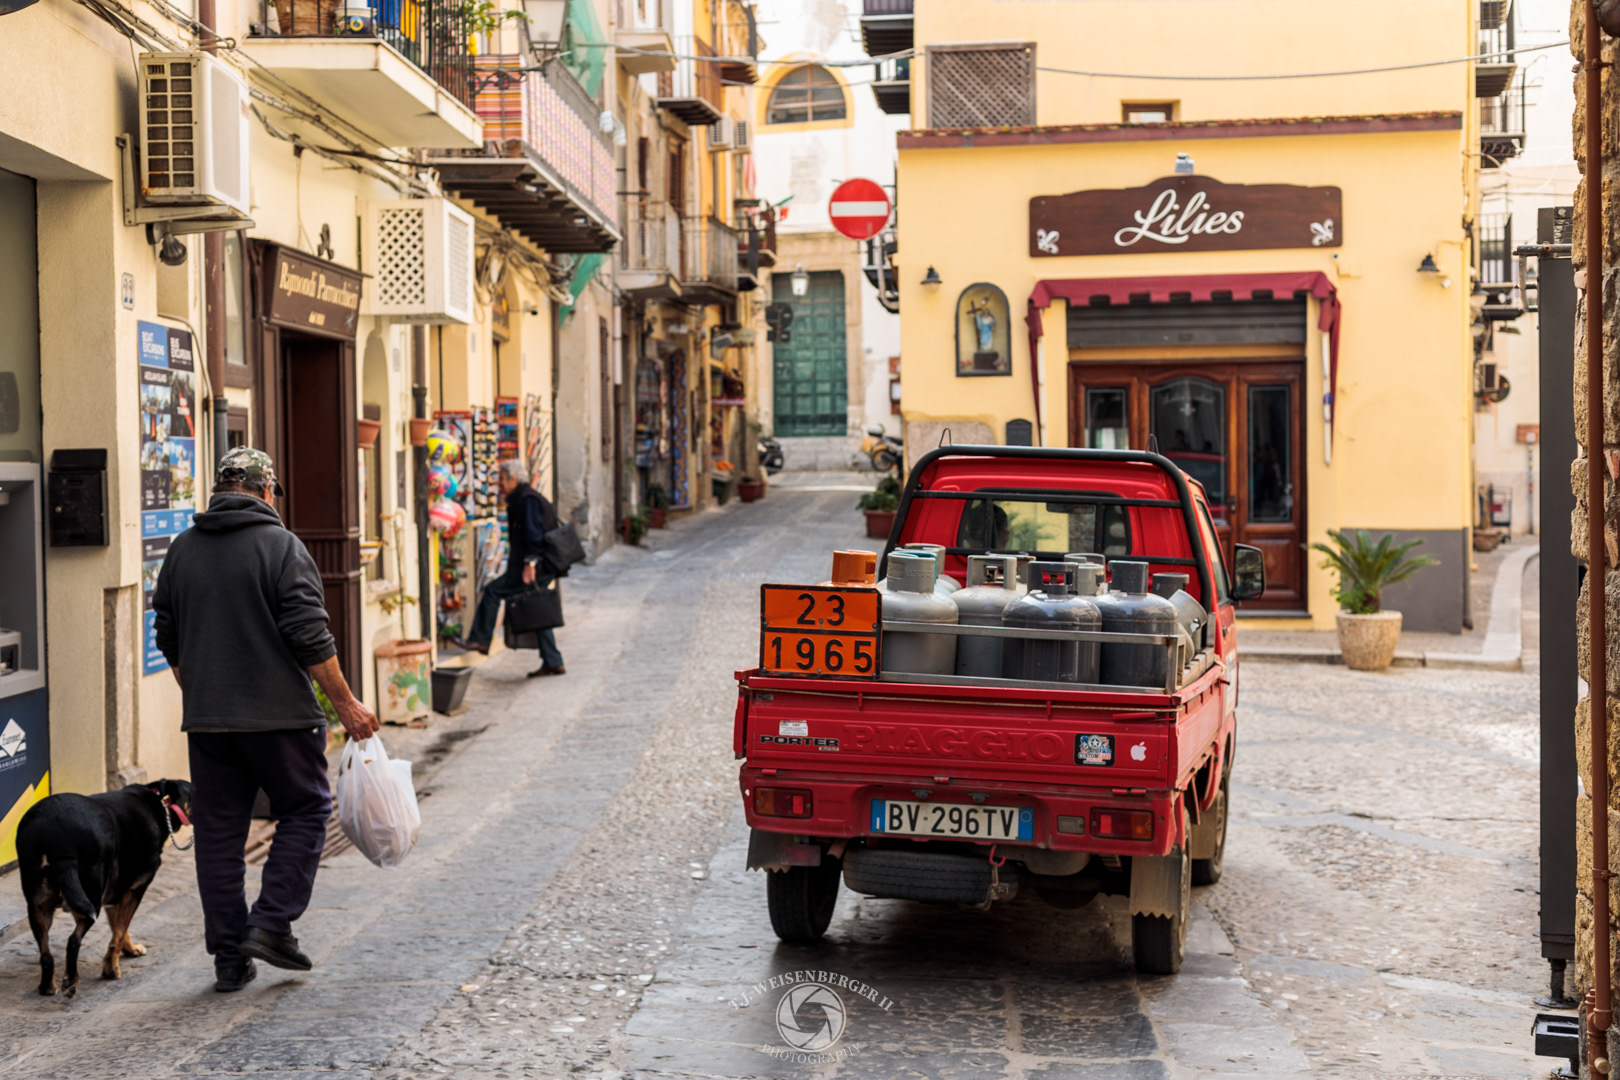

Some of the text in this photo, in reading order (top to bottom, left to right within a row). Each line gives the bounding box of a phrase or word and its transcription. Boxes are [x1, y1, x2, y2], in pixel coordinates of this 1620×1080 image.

[1114, 188, 1245, 247] Lilies
[797, 593, 845, 626] 23
[771, 636, 873, 673] 1965
[760, 735, 840, 748] PORTER
[842, 724, 1066, 763] PIAGGIO
